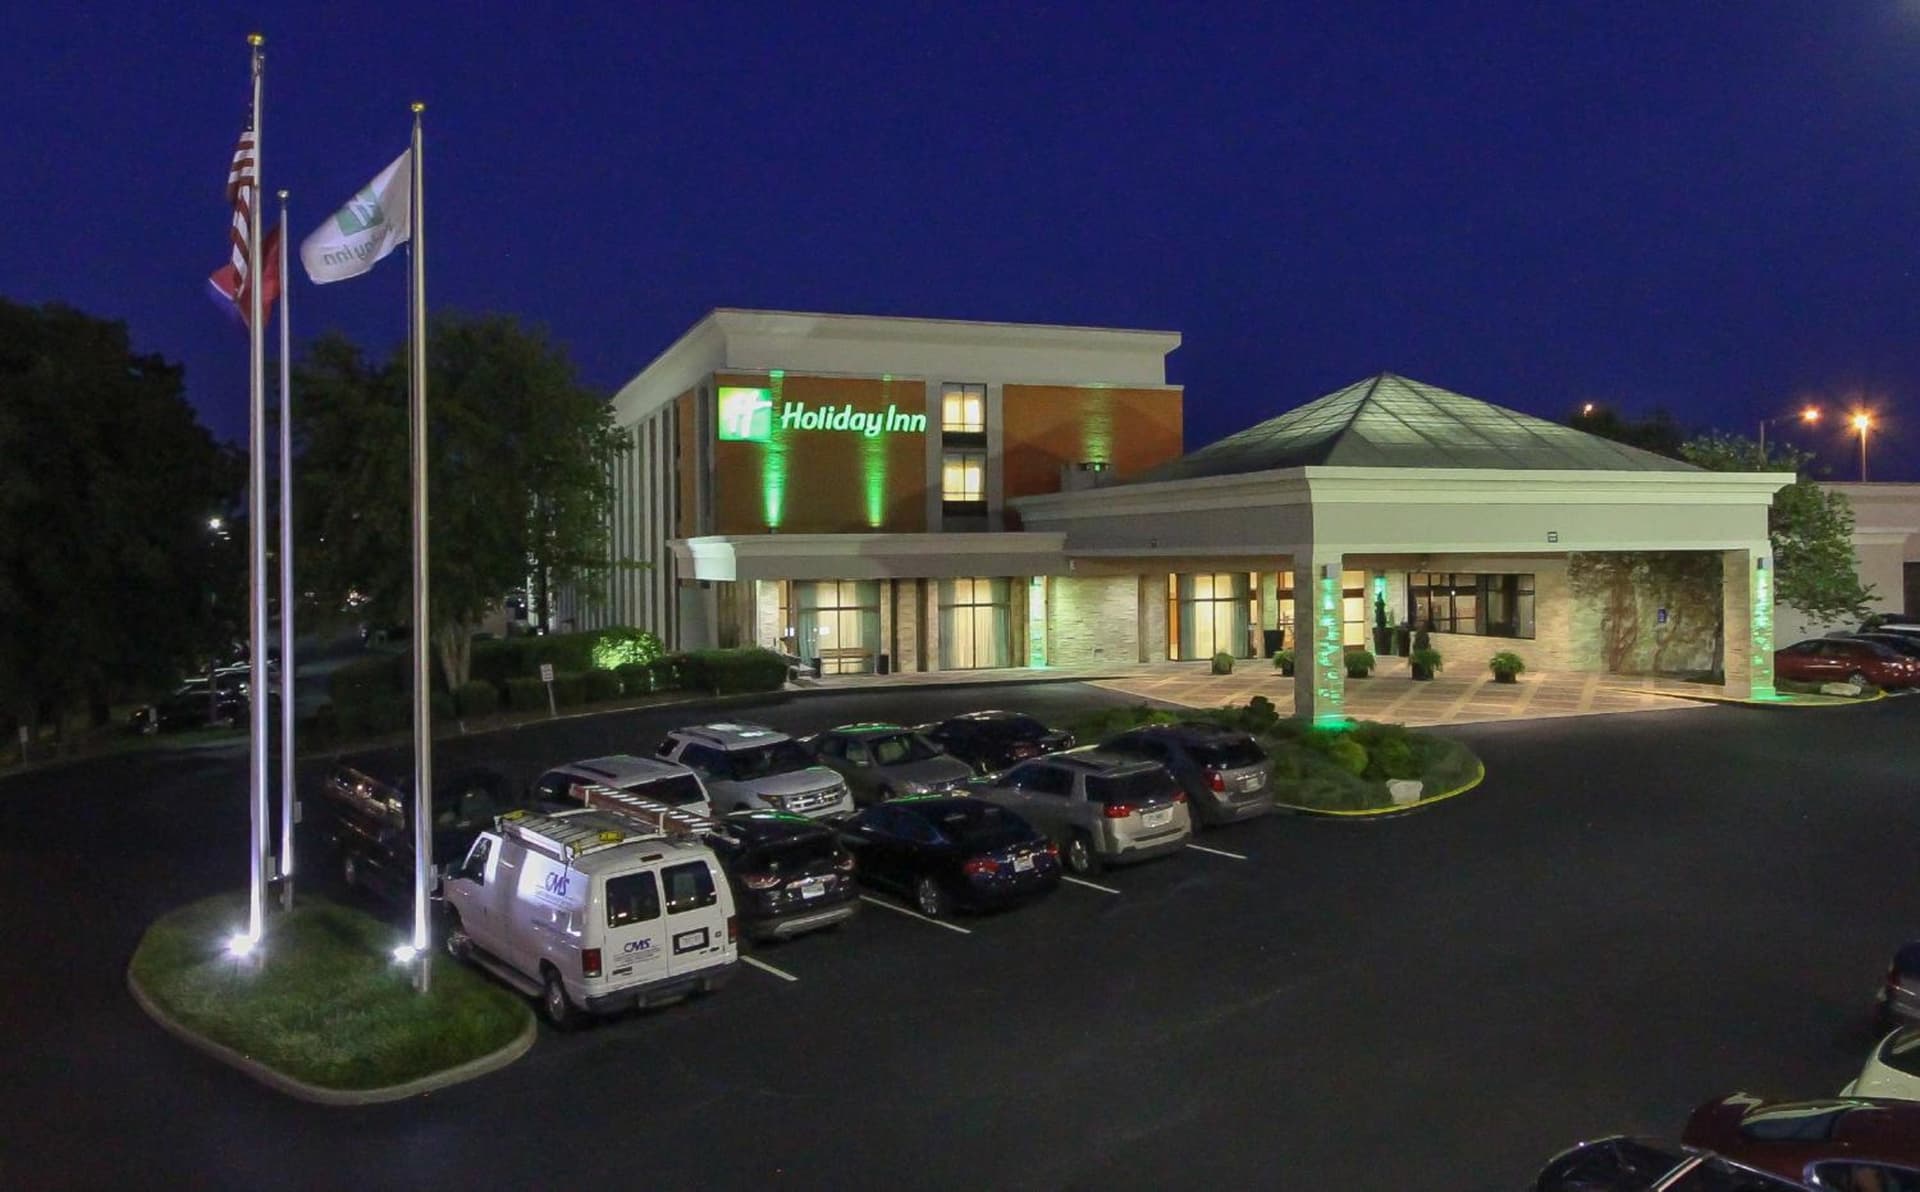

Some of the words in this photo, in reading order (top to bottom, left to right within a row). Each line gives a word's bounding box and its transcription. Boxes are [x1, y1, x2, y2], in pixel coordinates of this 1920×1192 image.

[781, 402, 883, 437] Holiday
[886, 404, 926, 433] Inn
[545, 872, 570, 897] CMS
[624, 937, 651, 953] CMS
